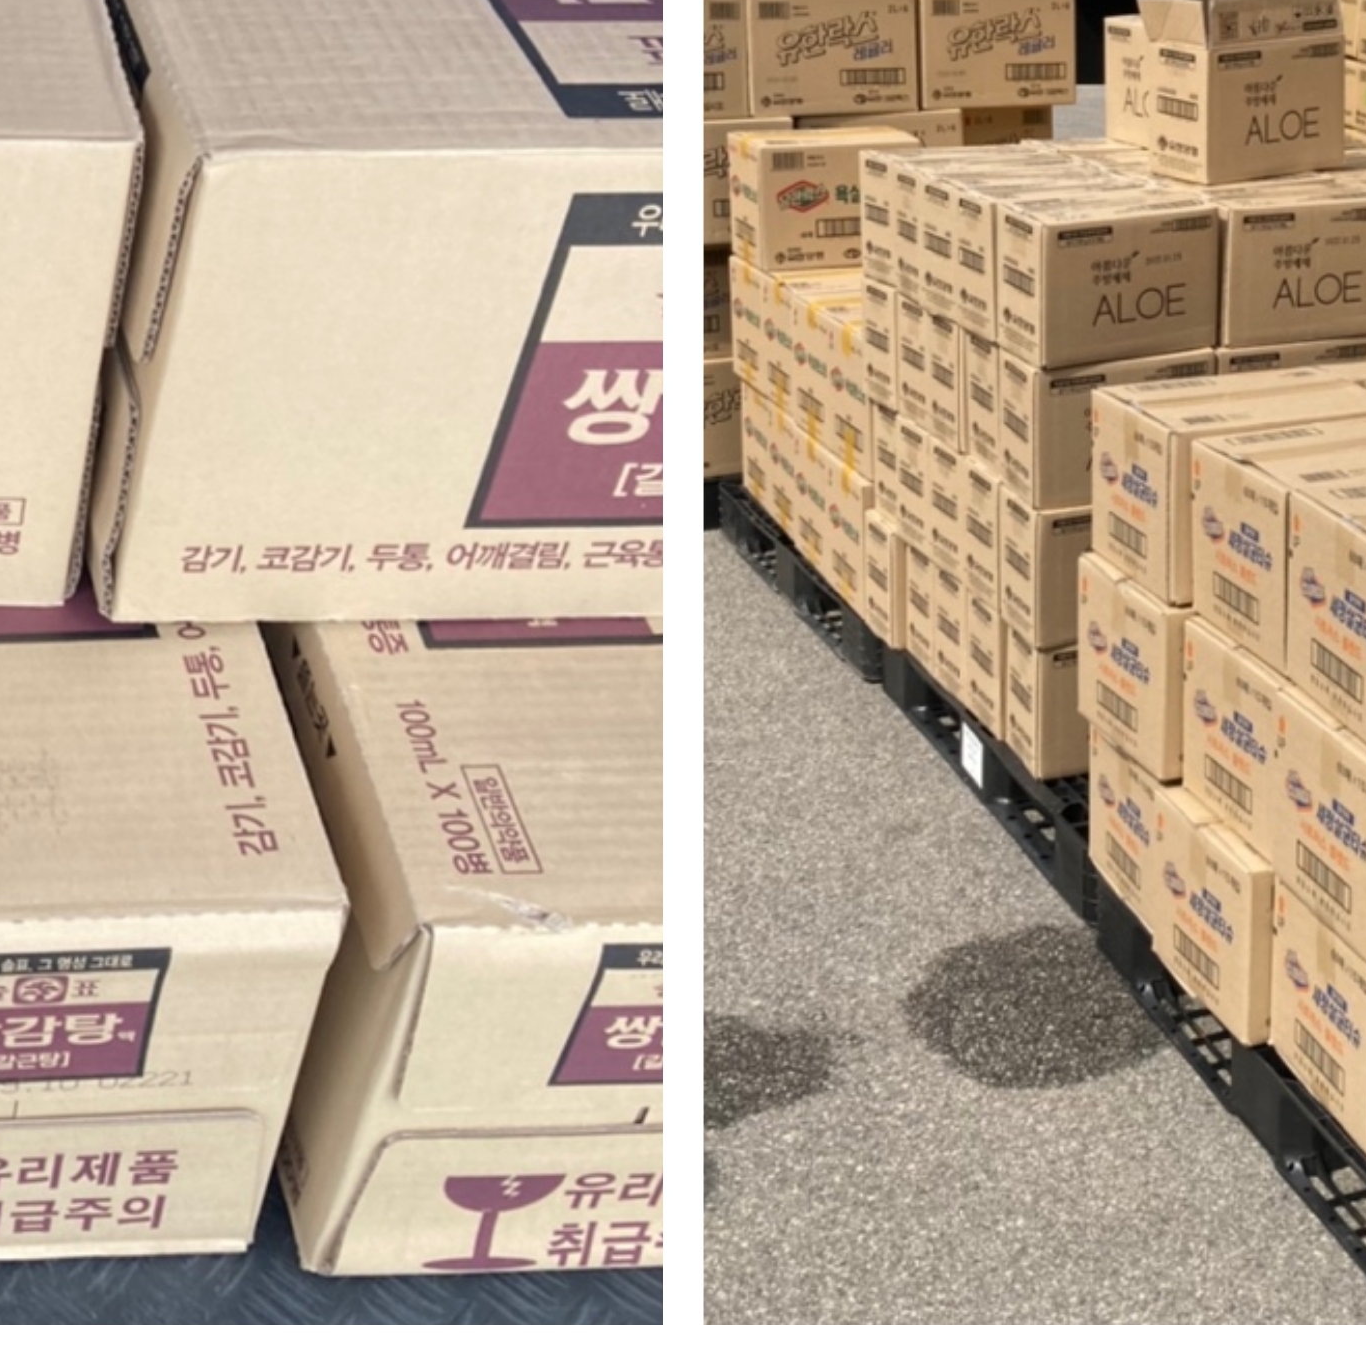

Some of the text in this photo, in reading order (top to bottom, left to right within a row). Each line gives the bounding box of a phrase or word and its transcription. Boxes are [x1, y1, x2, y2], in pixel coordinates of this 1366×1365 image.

[1245, 106, 1321, 146] ALOE
[1092, 283, 1187, 327] ALOE
[1273, 271, 1363, 310] ALOE
[181, 540, 570, 574] 감기, 코감기, 두통, 어깨결림,
[182, 646, 279, 858] 감기, 코감기, 두통,
[71, 979, 101, 998] 표
